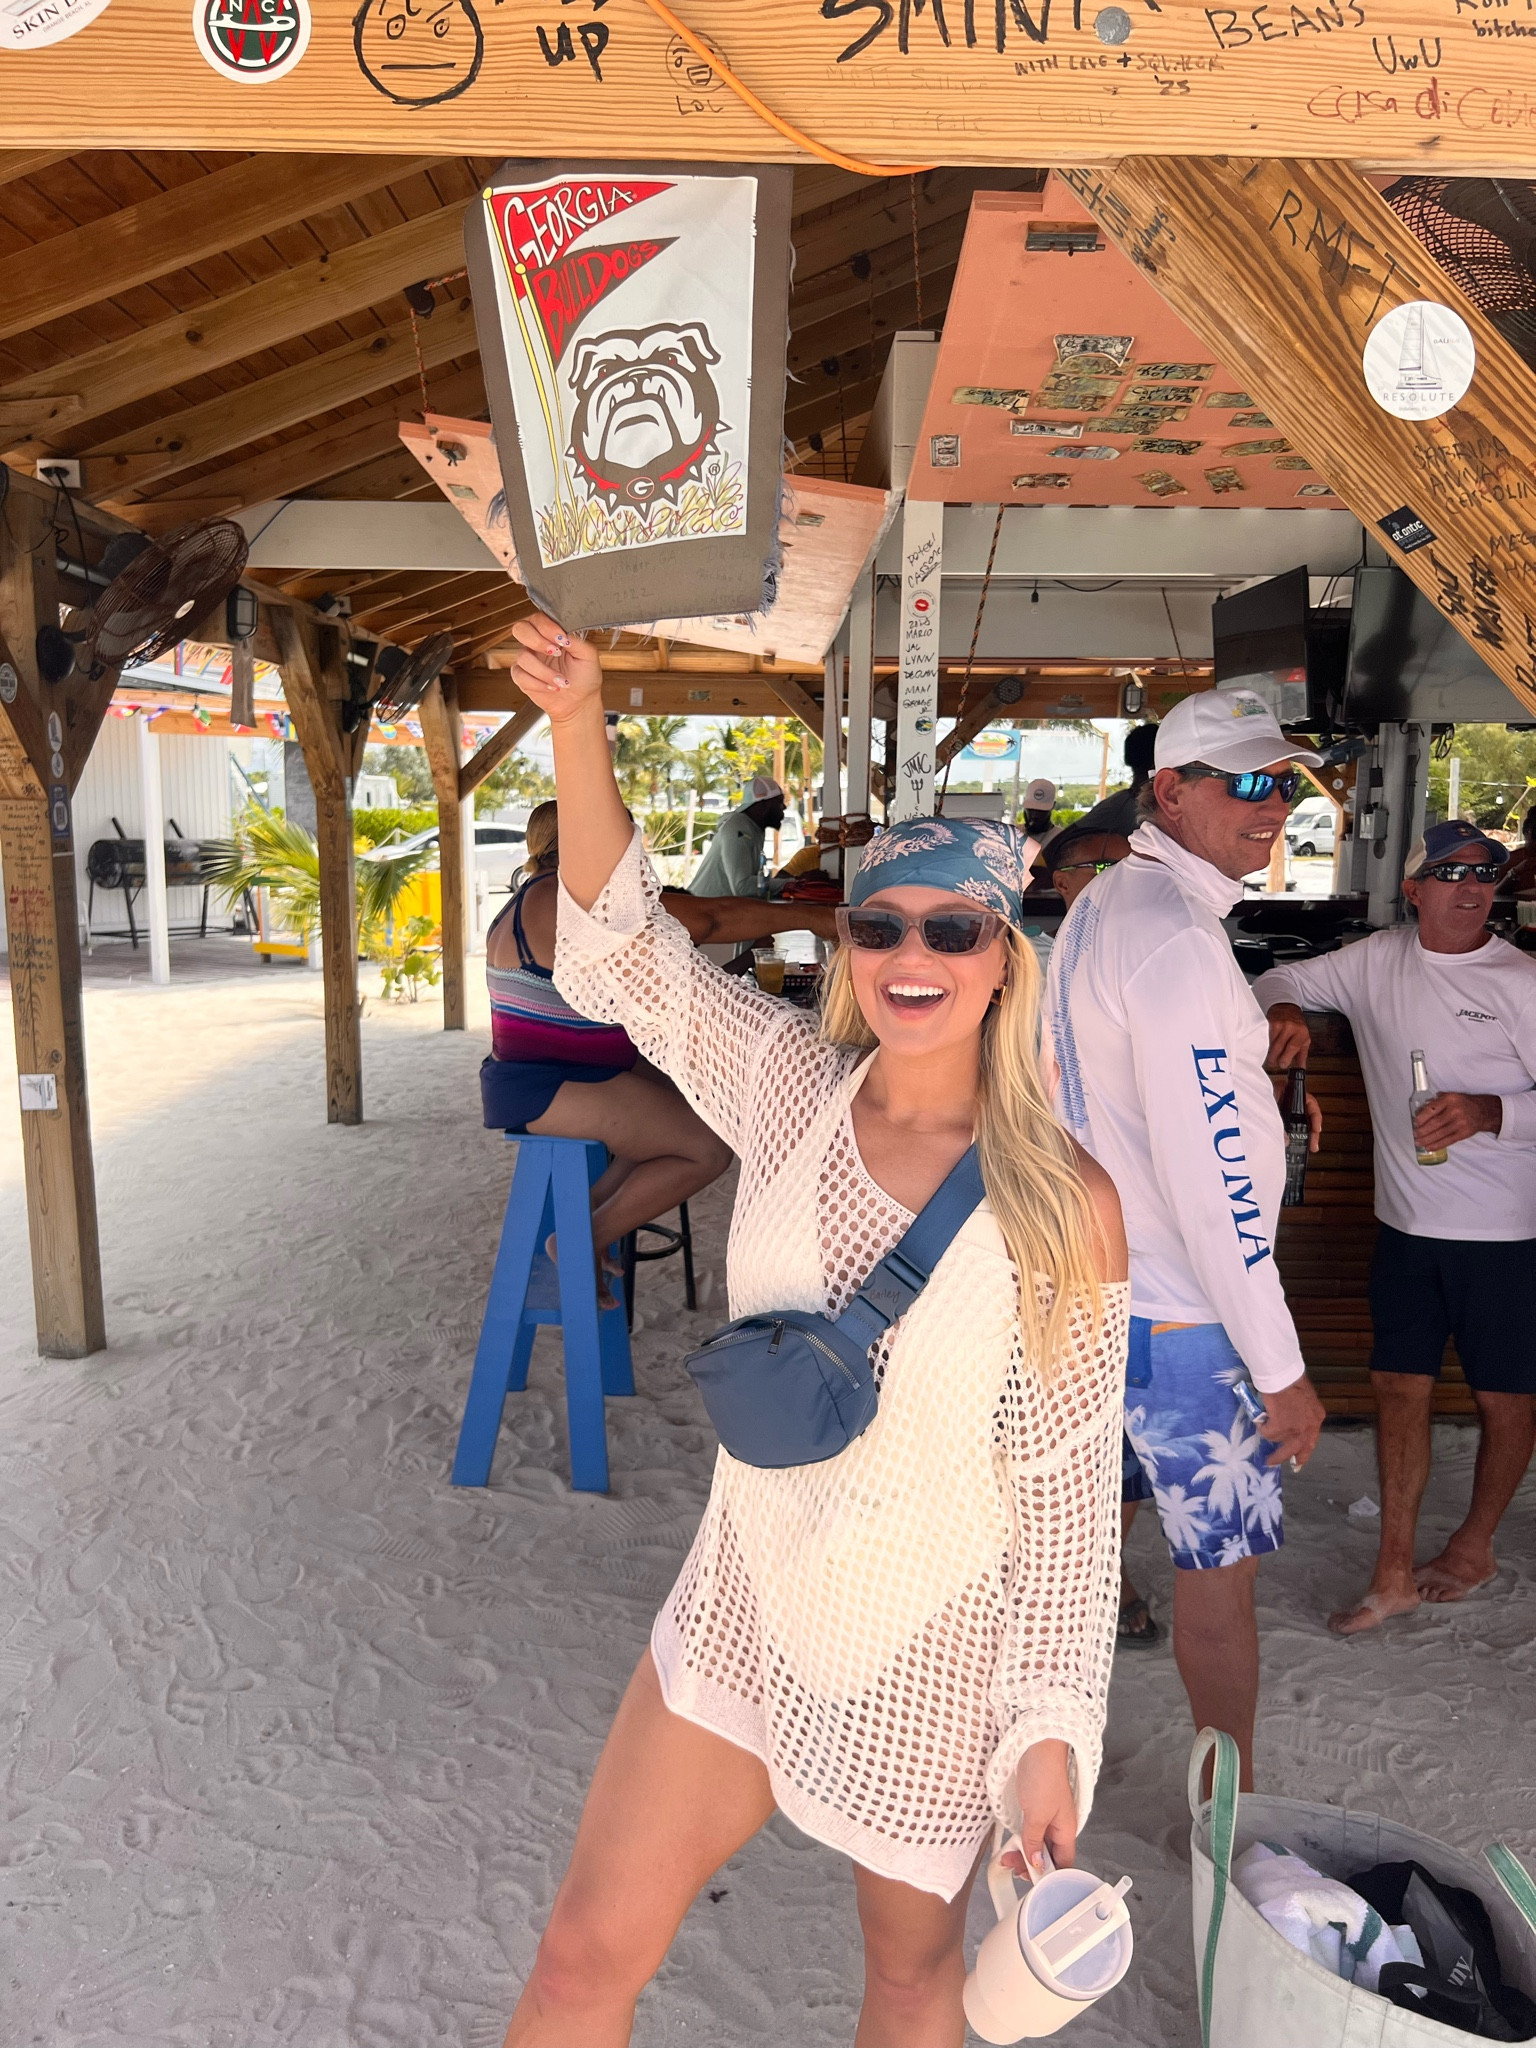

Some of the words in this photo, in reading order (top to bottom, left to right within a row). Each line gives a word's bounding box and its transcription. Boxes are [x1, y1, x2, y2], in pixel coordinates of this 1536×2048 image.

[12, 3, 61, 40] SKIN
[1205, 0, 1366, 49] BEANS
[503, 185, 635, 268] GEORGIA
[531, 240, 660, 360] BULLDOGS
[1383, 392, 1455, 402] RESOLUTE
[905, 652, 935, 665] LYNN
[1191, 1043, 1272, 1275] EXUMA
